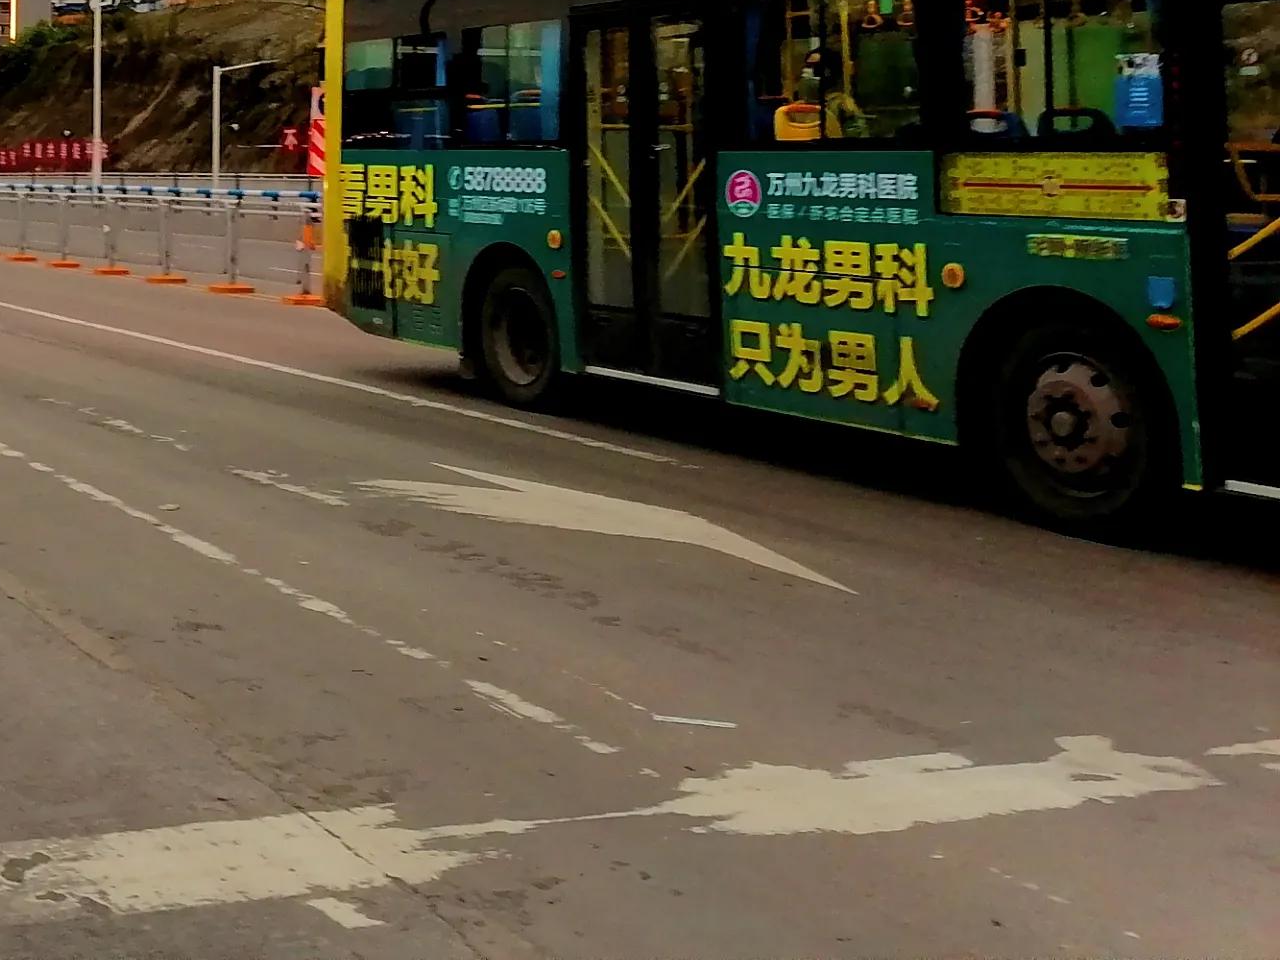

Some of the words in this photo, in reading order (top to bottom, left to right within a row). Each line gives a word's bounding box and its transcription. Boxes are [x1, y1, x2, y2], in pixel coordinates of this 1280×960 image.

[464, 166, 547, 194] 58788888
[766, 171, 920, 200] 万州九龙男科医院
[723, 232, 934, 317] 九龙男科
[729, 319, 940, 412] 只为男人
